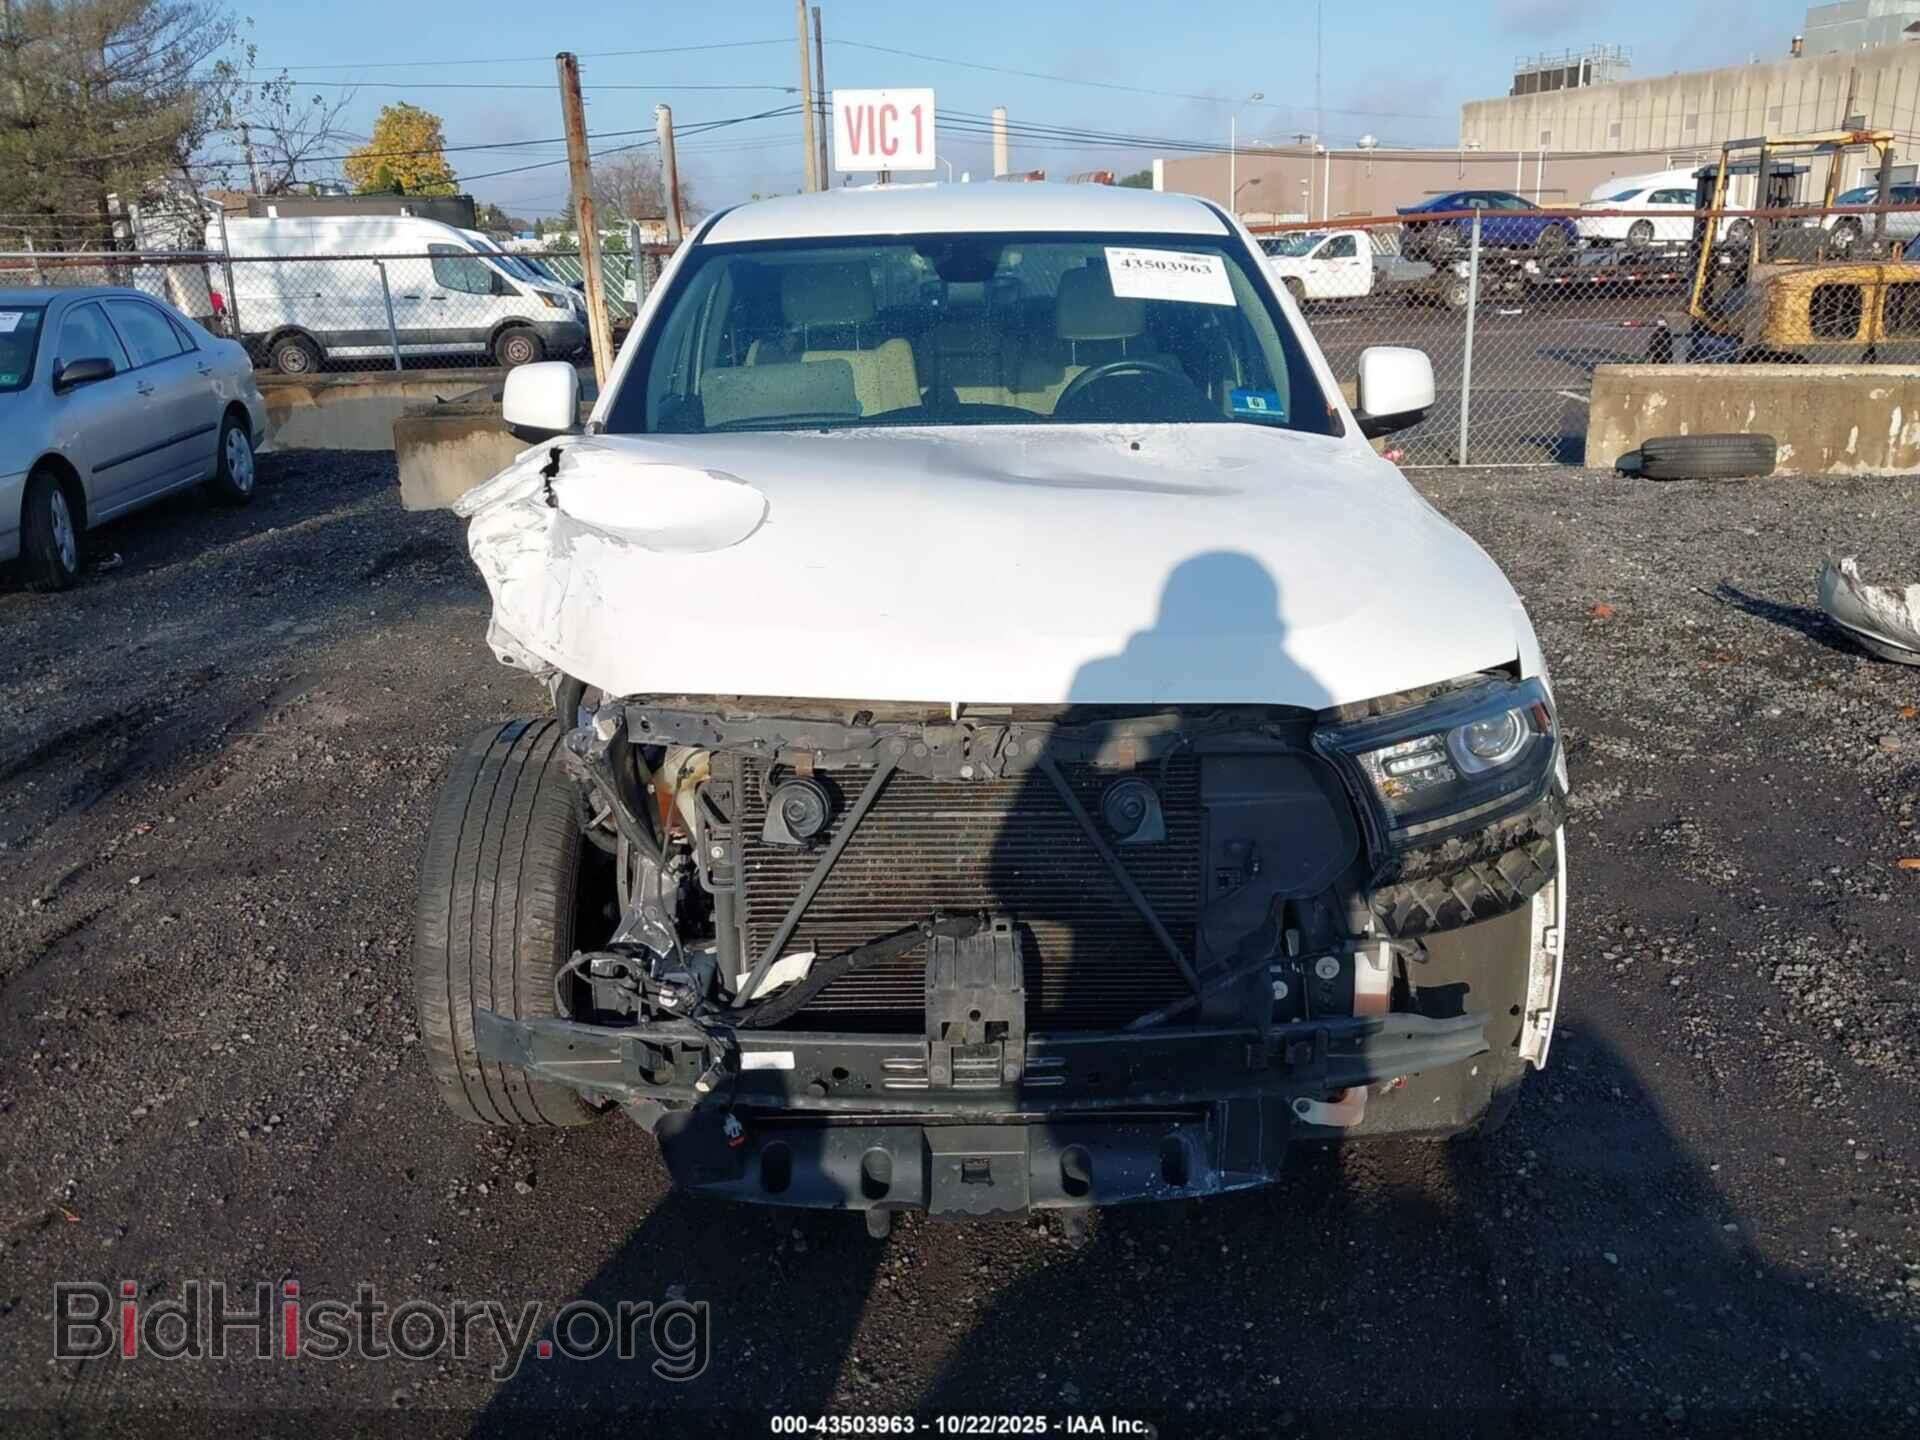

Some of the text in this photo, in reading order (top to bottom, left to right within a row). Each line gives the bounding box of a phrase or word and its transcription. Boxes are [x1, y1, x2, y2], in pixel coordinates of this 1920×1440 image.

[844, 104, 923, 156] VIC 1
[1121, 258, 1212, 274] 43503963
